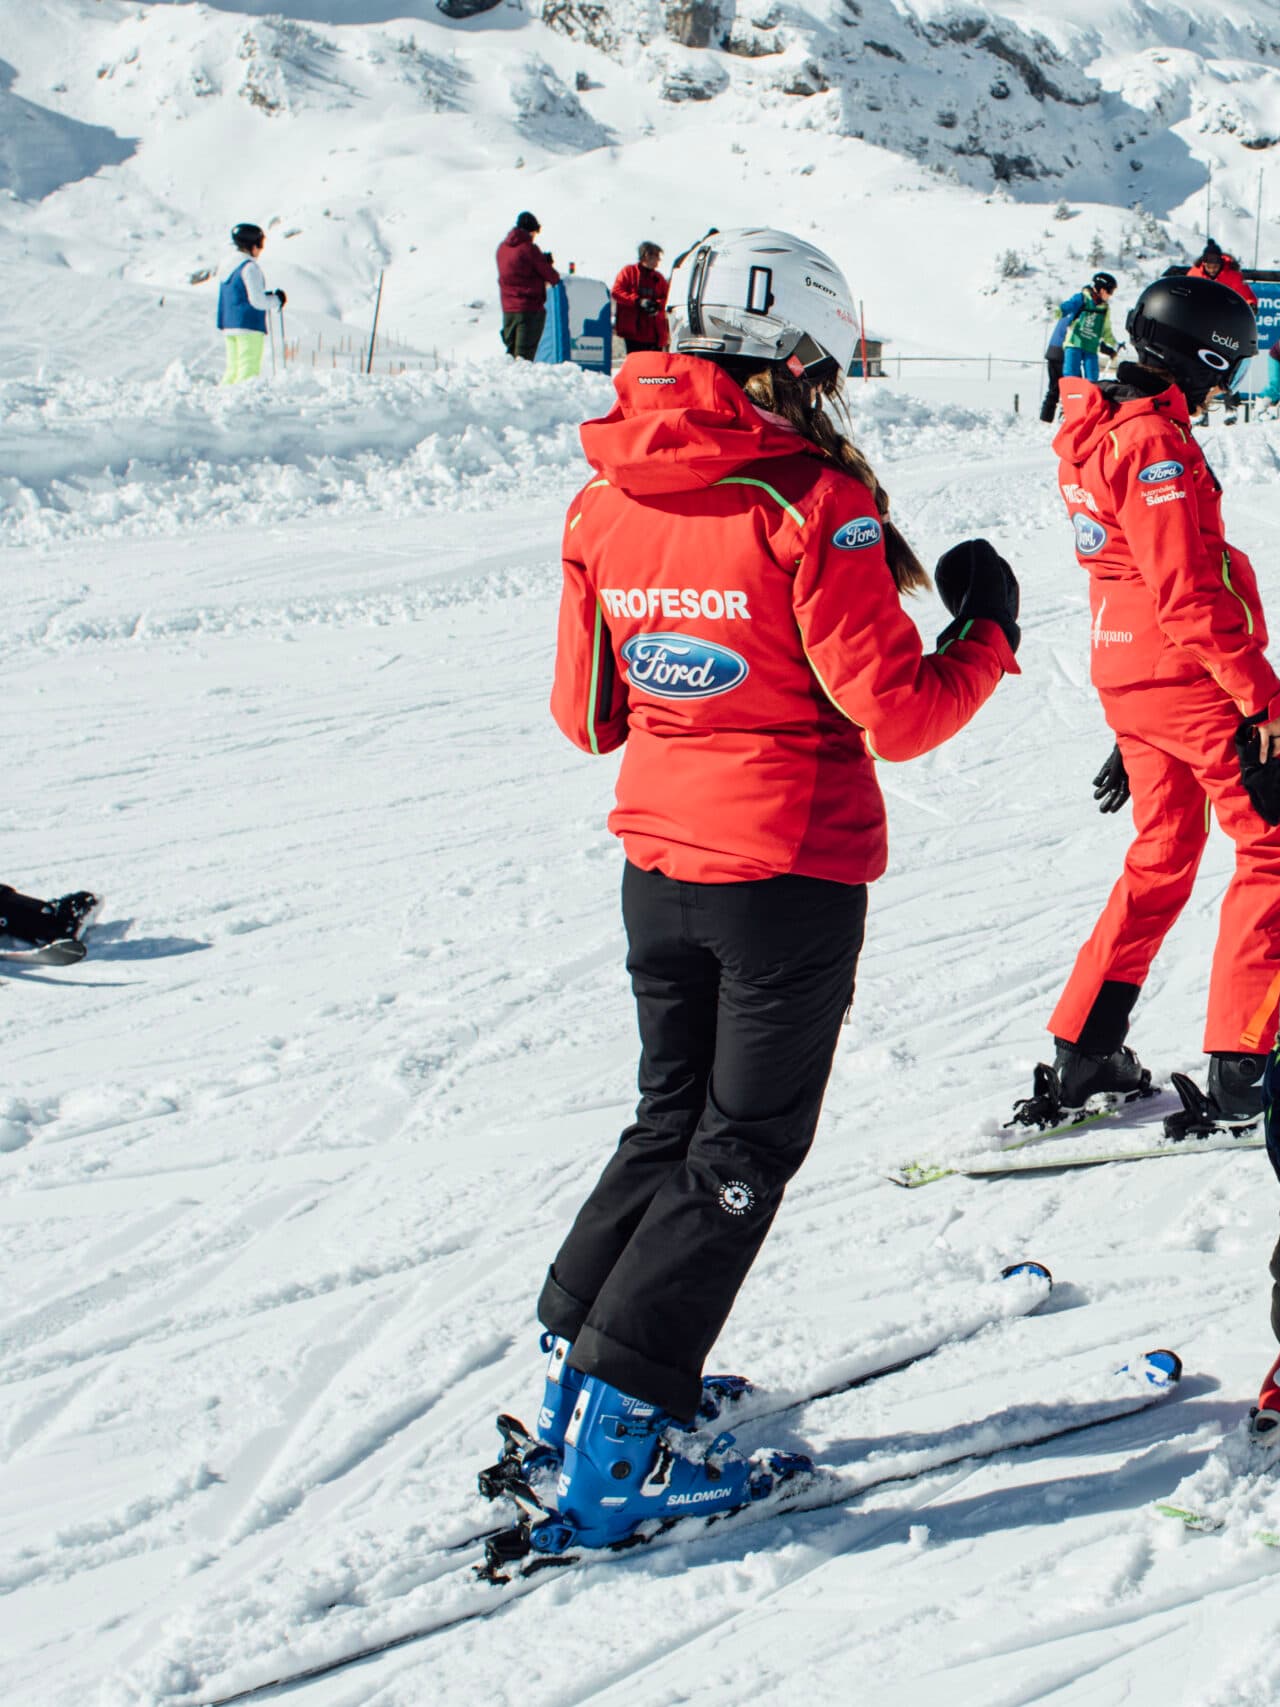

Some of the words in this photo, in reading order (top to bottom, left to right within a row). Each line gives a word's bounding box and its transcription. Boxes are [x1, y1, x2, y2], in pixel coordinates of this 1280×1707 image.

[846, 521, 877, 546] Ford
[632, 642, 715, 688] Ford
[666, 1487, 732, 1506] SALOMON
